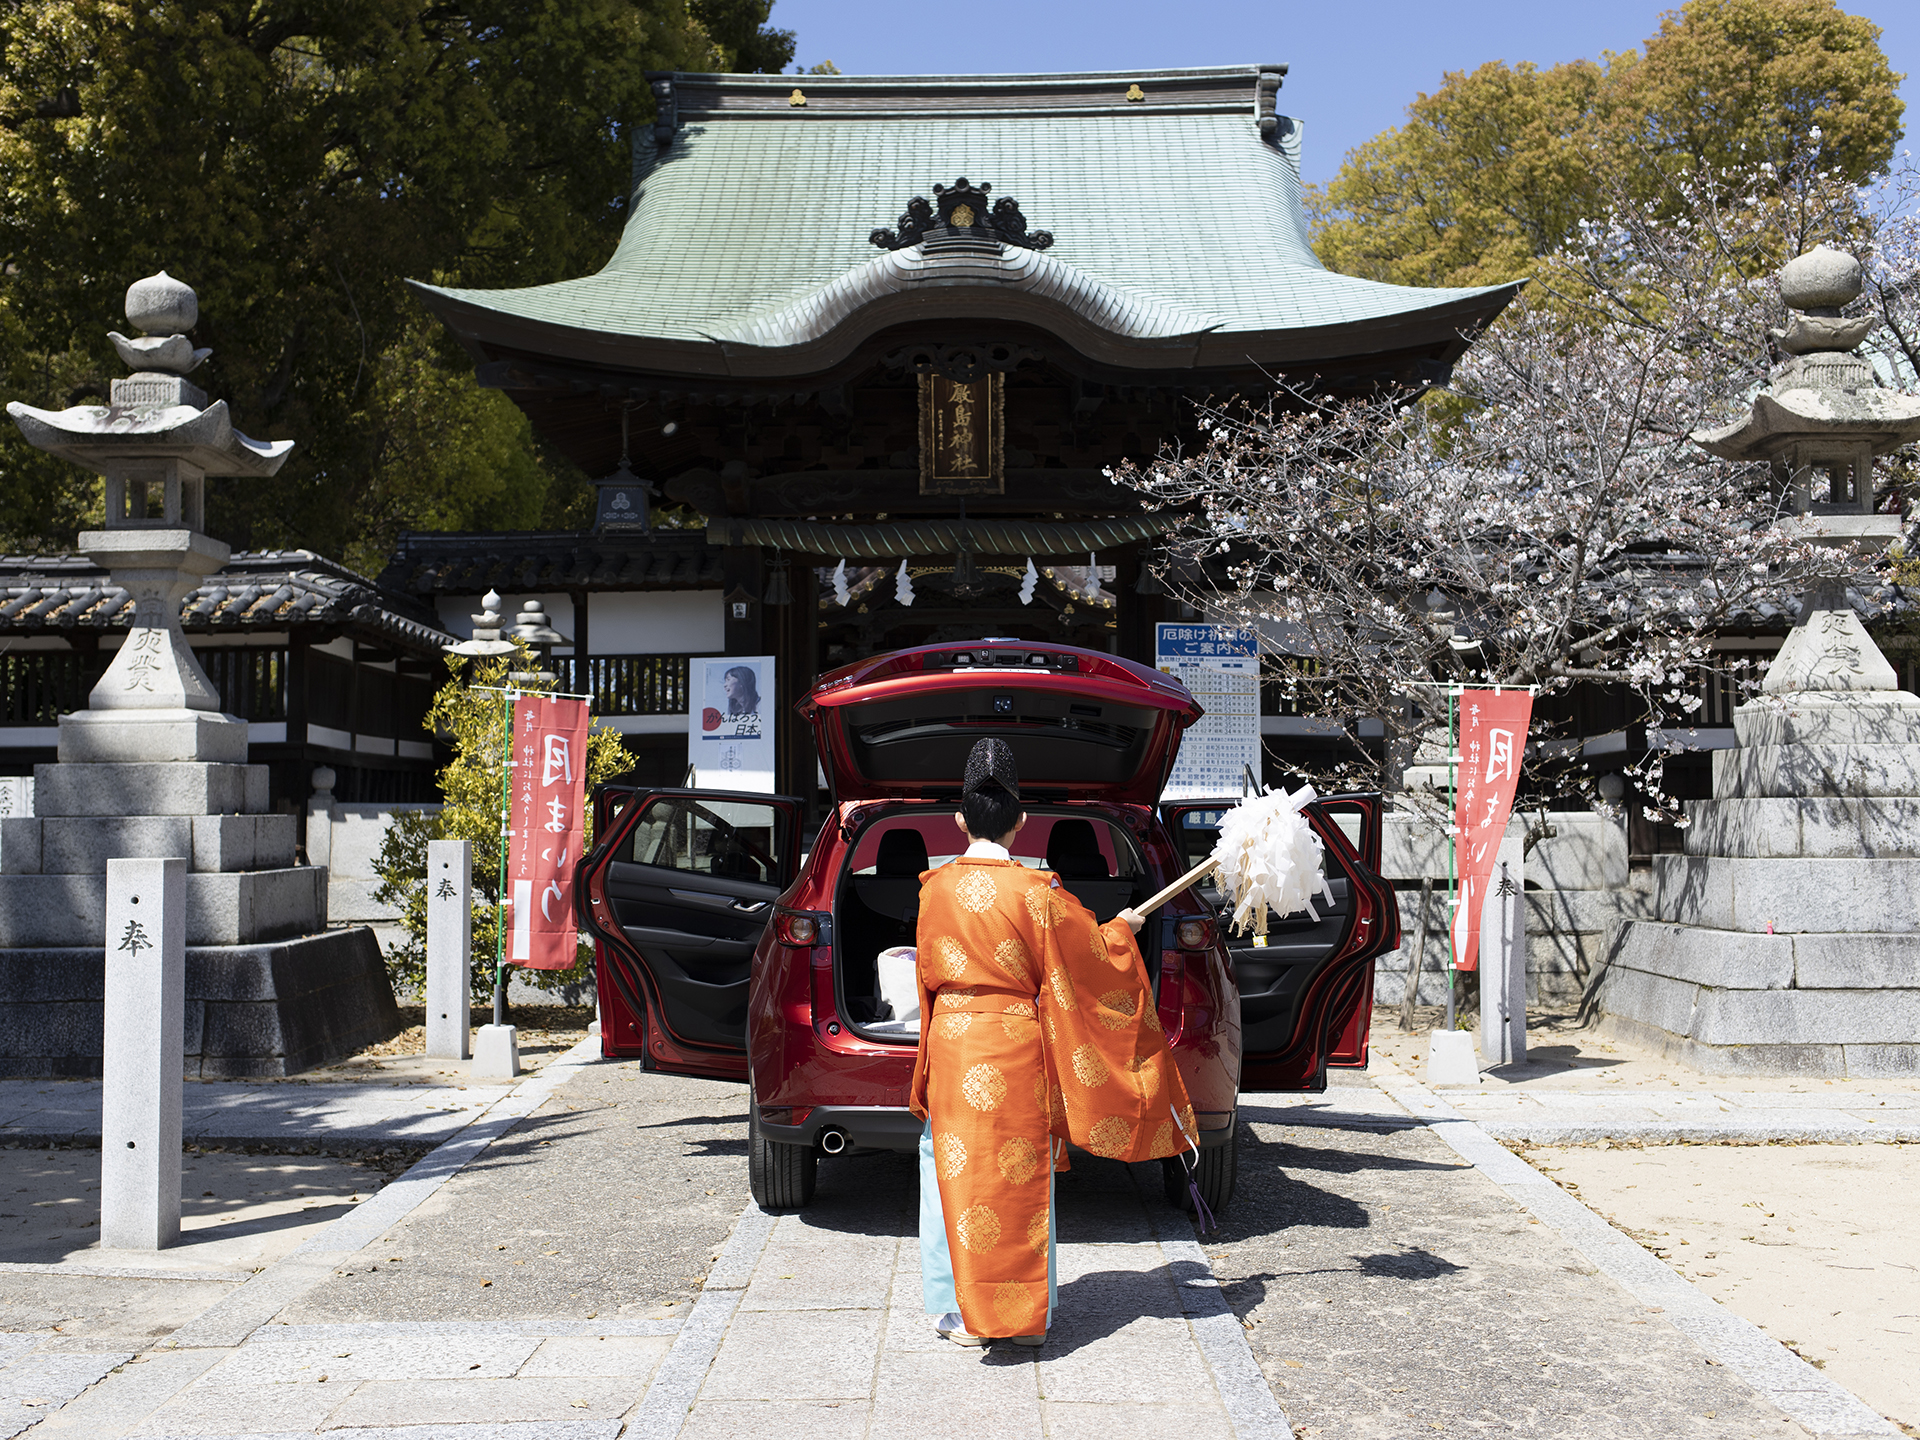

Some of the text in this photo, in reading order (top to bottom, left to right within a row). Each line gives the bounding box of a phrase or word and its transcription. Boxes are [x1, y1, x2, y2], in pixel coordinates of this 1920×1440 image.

[1184, 642, 1231, 654] ご案内
[735, 723, 762, 736] 日本。
[1188, 811, 1225, 824] 厳島
[435, 878, 457, 901] 奉
[1494, 877, 1518, 901] 奉
[117, 919, 154, 957] 奉
